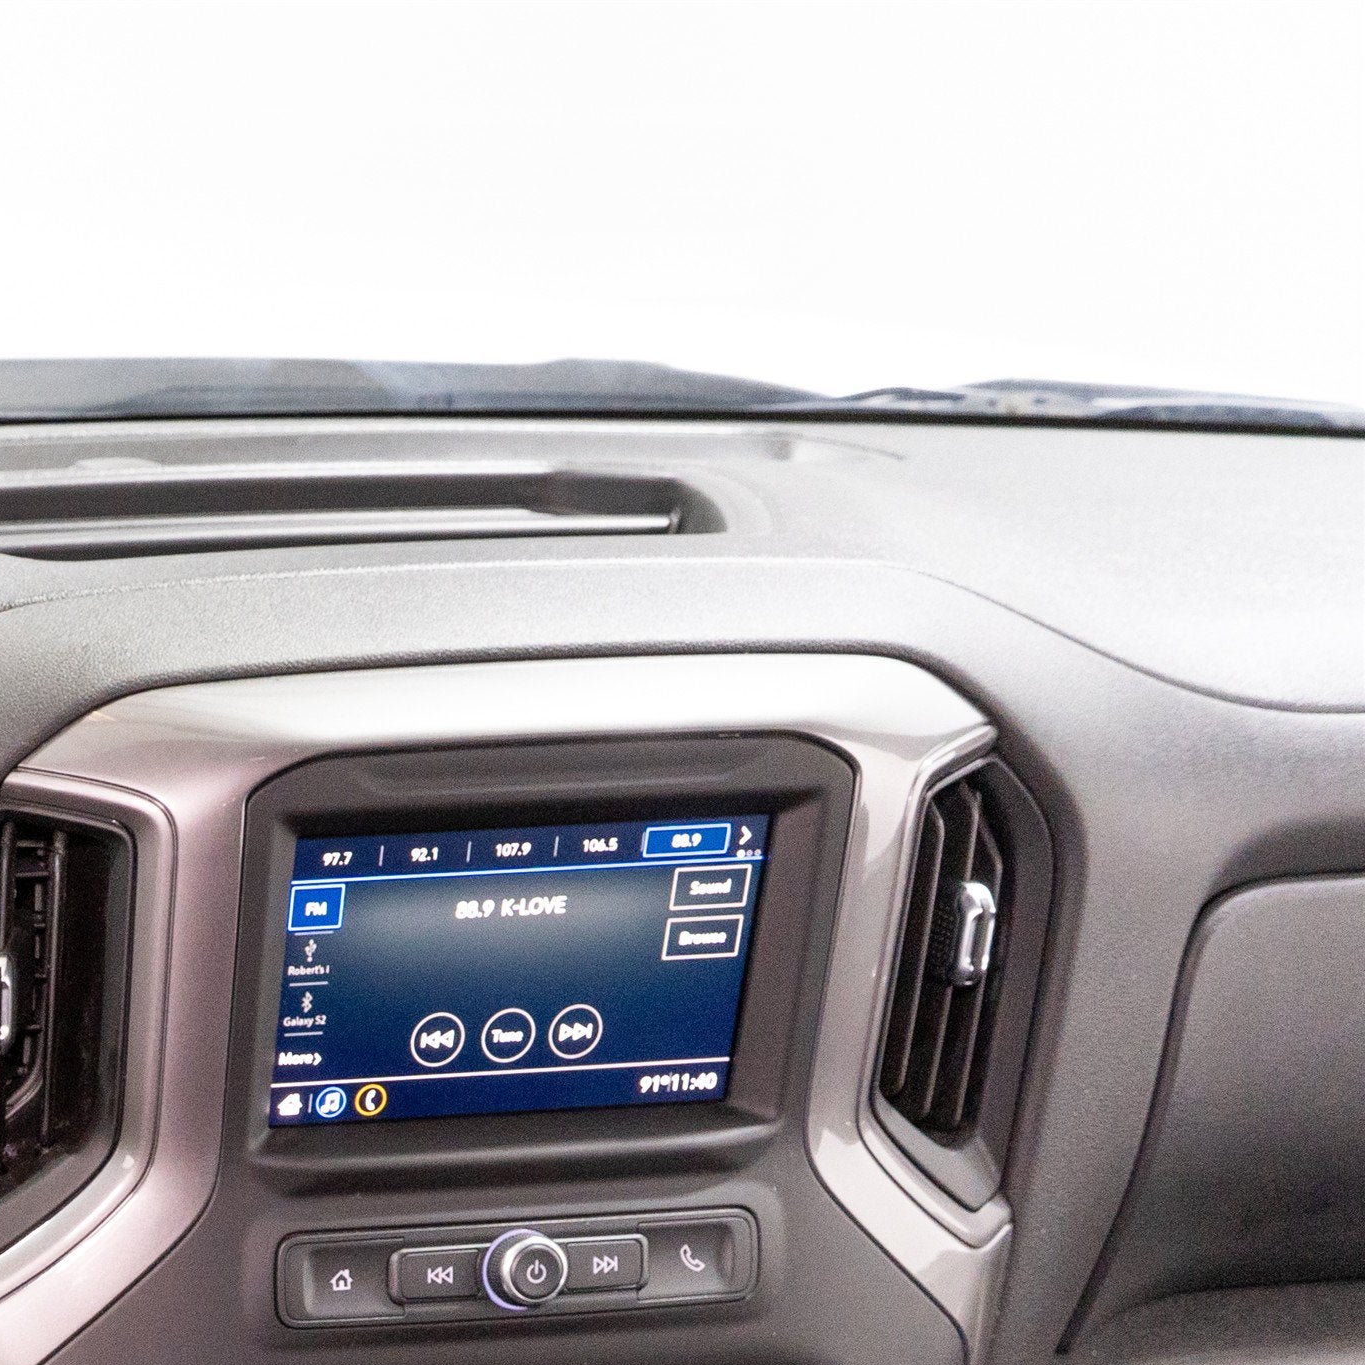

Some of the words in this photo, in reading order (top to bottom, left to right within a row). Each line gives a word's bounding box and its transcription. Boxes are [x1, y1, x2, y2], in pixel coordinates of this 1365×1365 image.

[410, 847, 439, 862] 92.1
[495, 842, 532, 857] 107.9
[322, 851, 353, 866] 97.7
[304, 901, 328, 917] FM
[500, 895, 568, 917] K-LOVE
